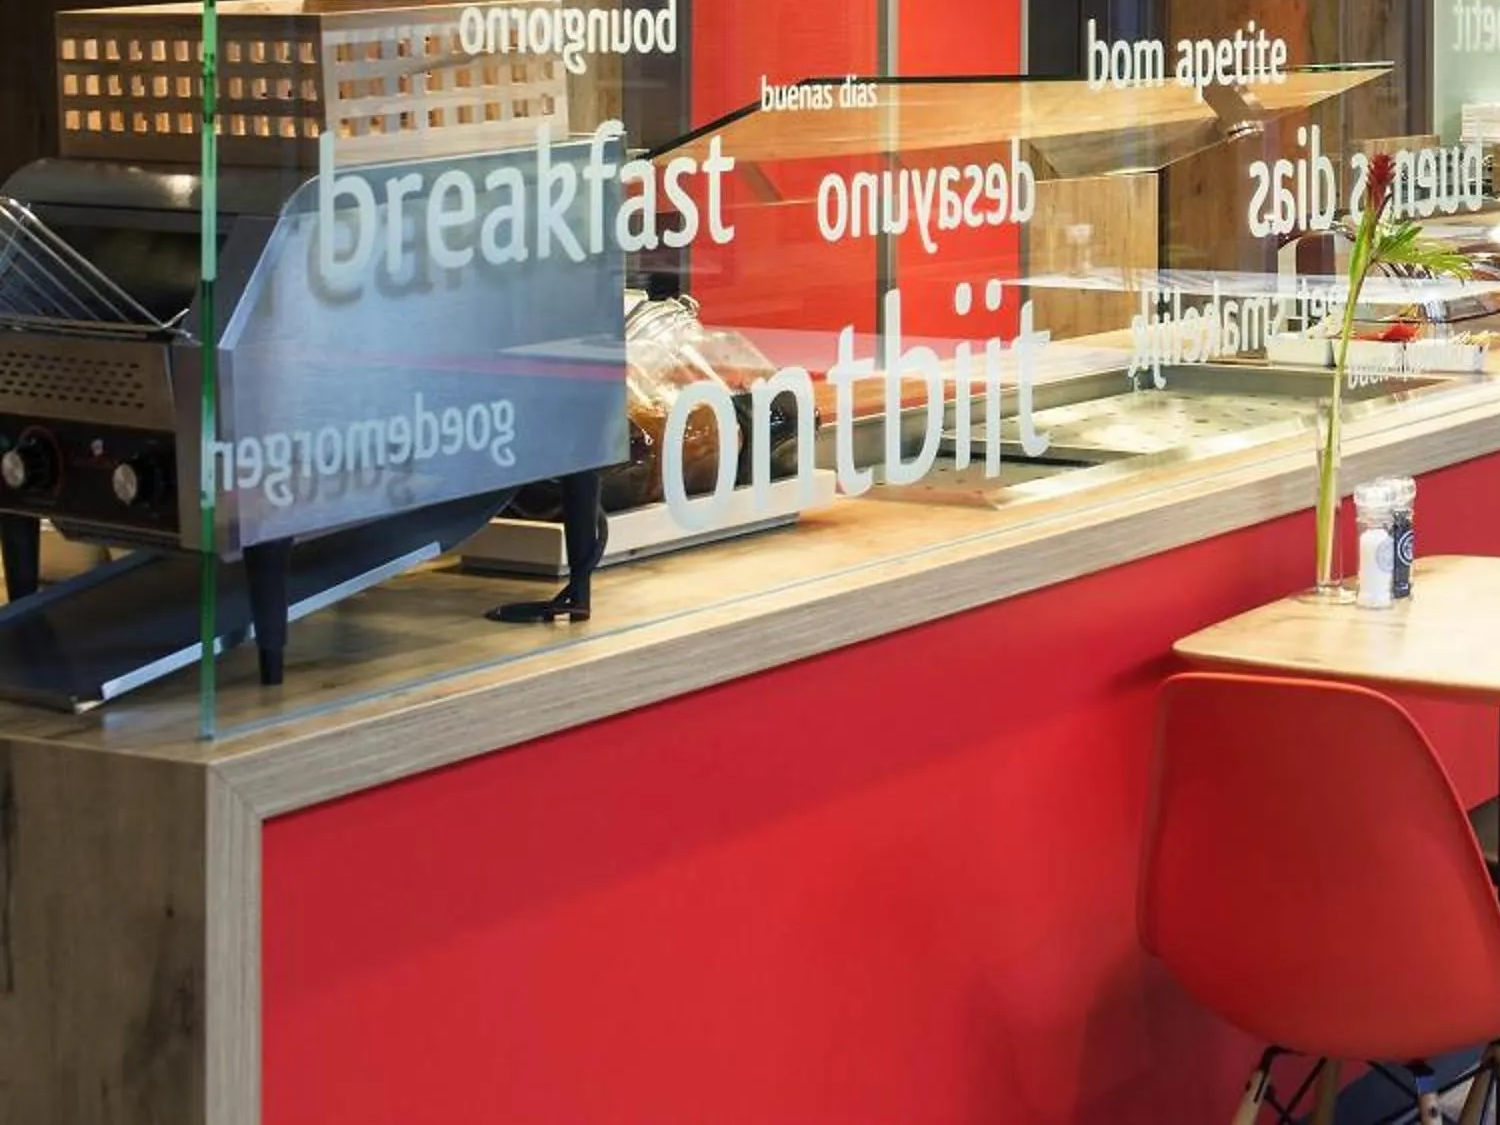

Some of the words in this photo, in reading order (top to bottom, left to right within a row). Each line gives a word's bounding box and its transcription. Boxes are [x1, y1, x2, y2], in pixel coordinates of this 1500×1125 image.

[760, 75, 834, 113] buenas
[838, 73, 878, 110] dias
[1087, 18, 1165, 91] bom
[1175, 20, 1288, 104] apetite
[317, 119, 735, 279] breakfast
